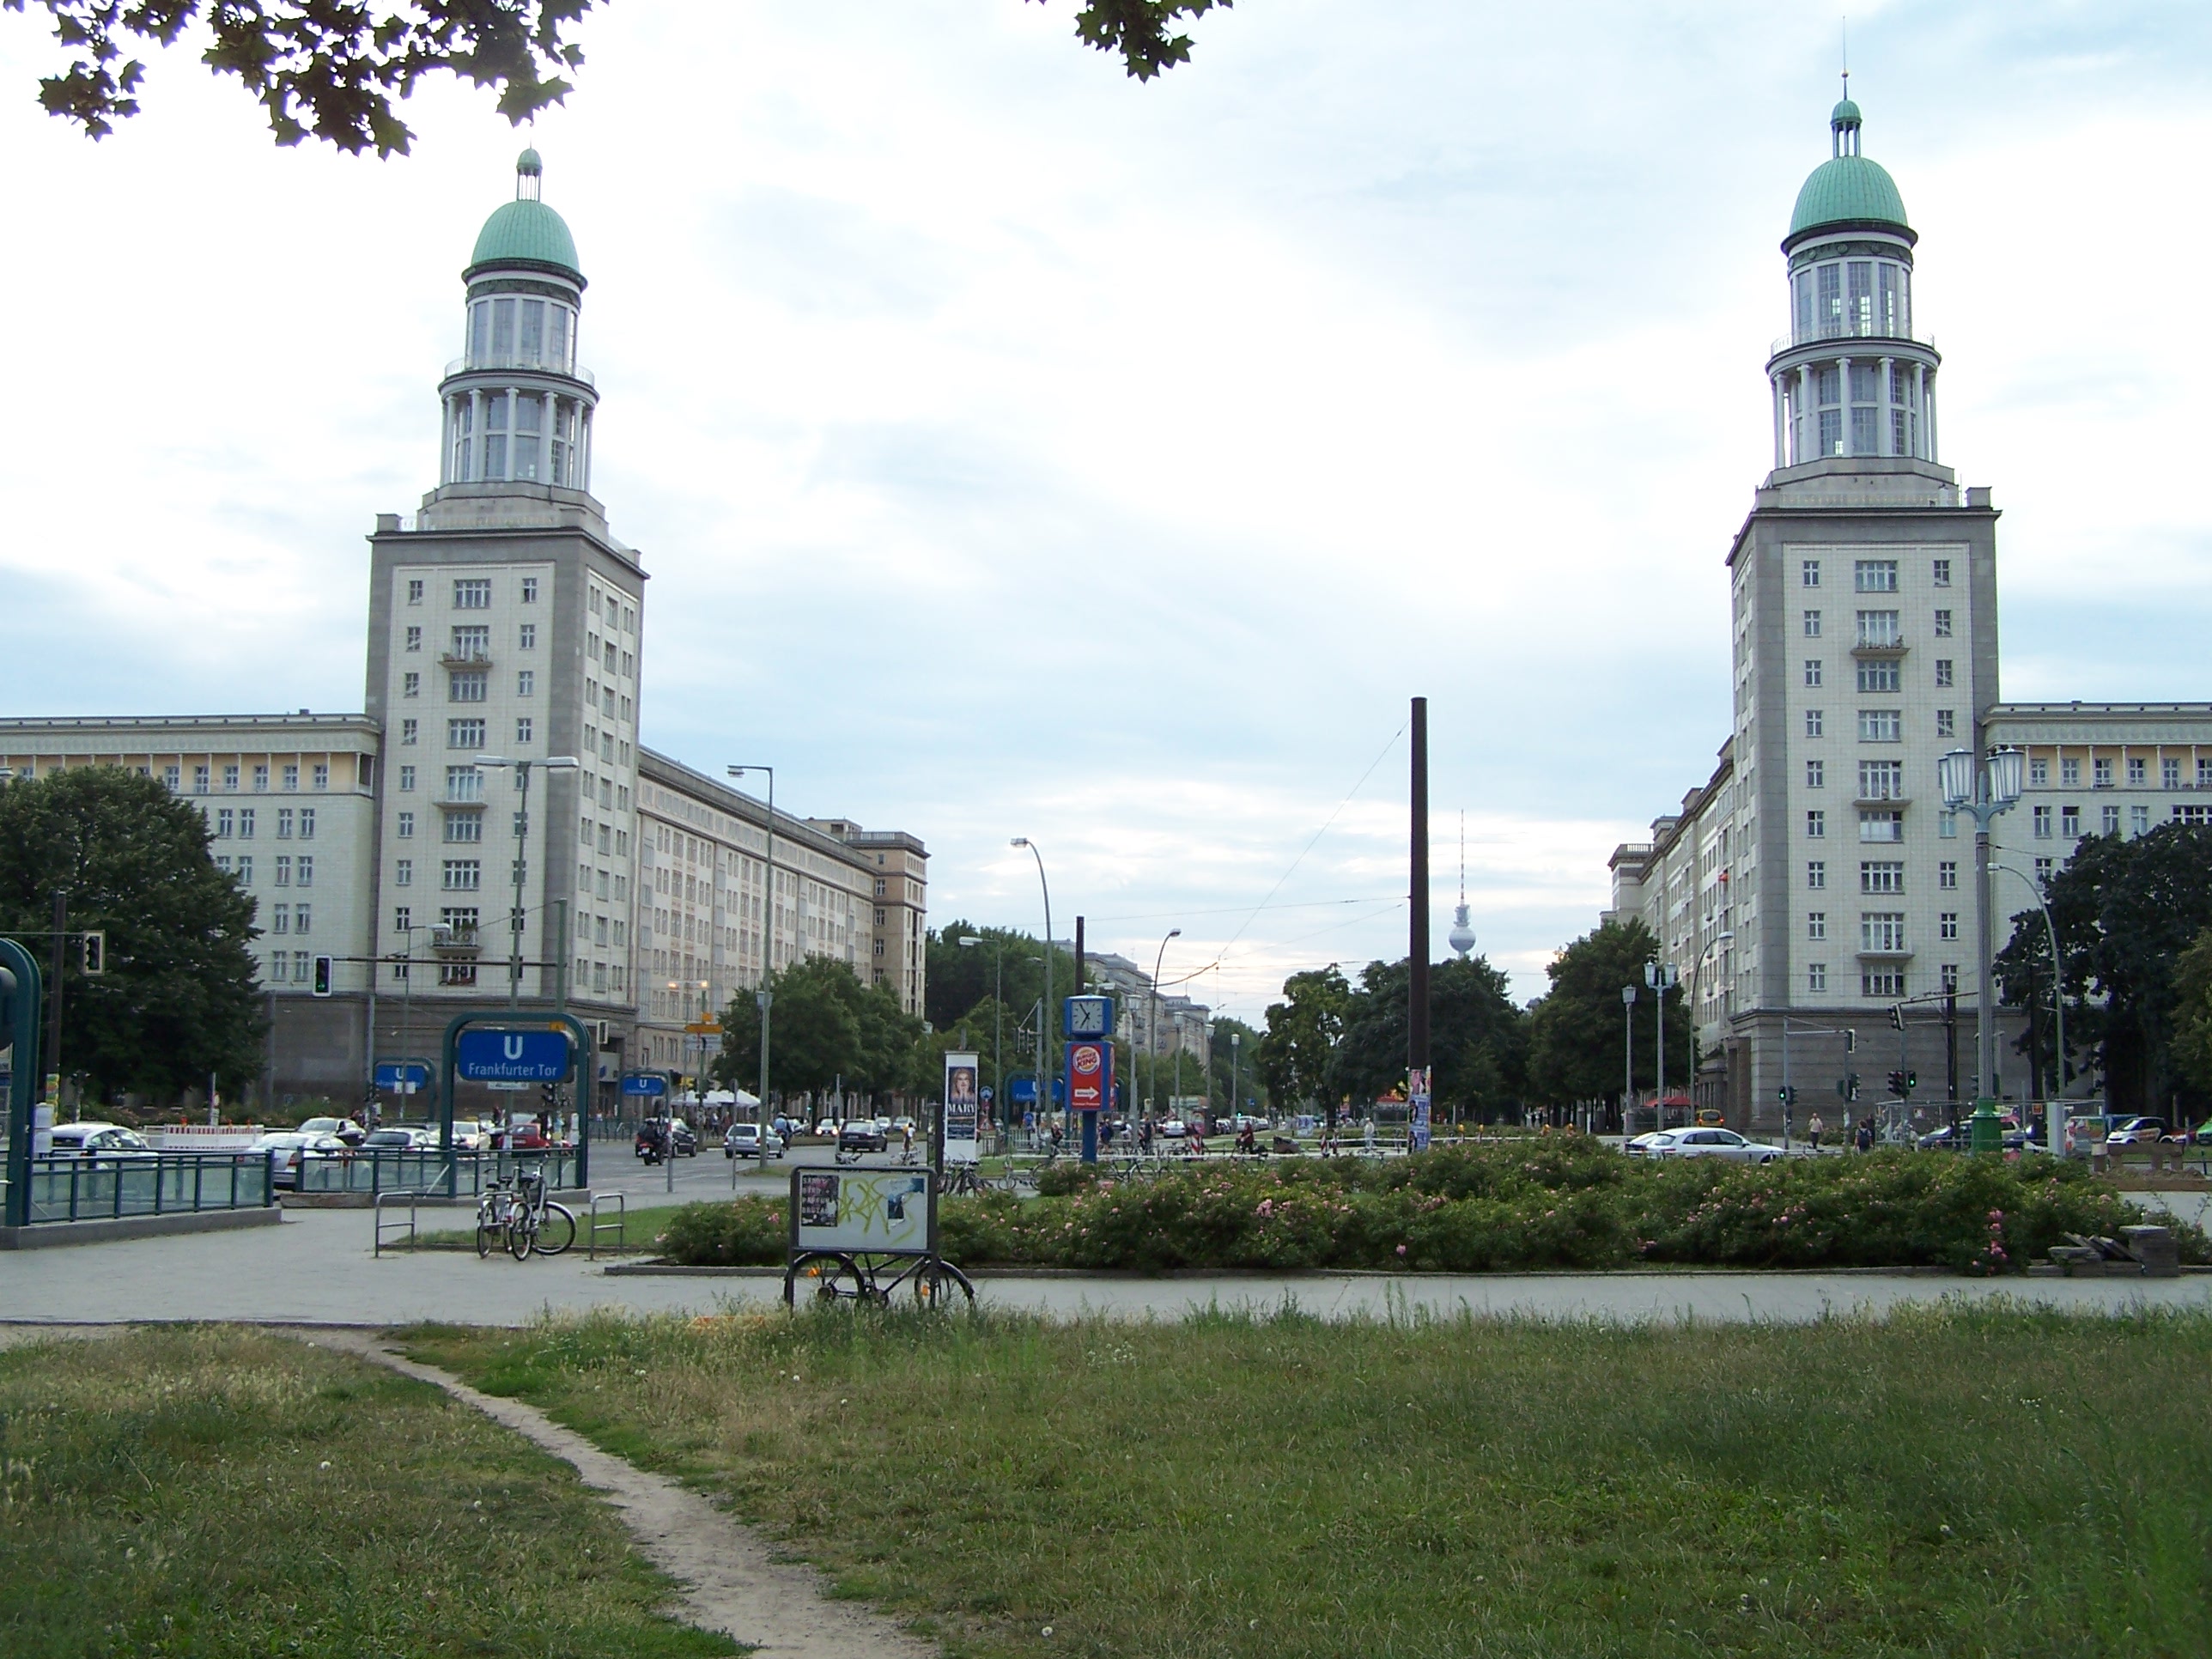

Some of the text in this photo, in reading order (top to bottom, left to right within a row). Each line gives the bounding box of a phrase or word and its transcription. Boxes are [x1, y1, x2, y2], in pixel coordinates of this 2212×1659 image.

[504, 1036, 523, 1060] U
[1077, 1056, 1097, 1067] KING
[469, 1062, 556, 1077] Frankfurter Tor
[639, 1079, 647, 1089] U
[948, 1103, 975, 1113] MARY
